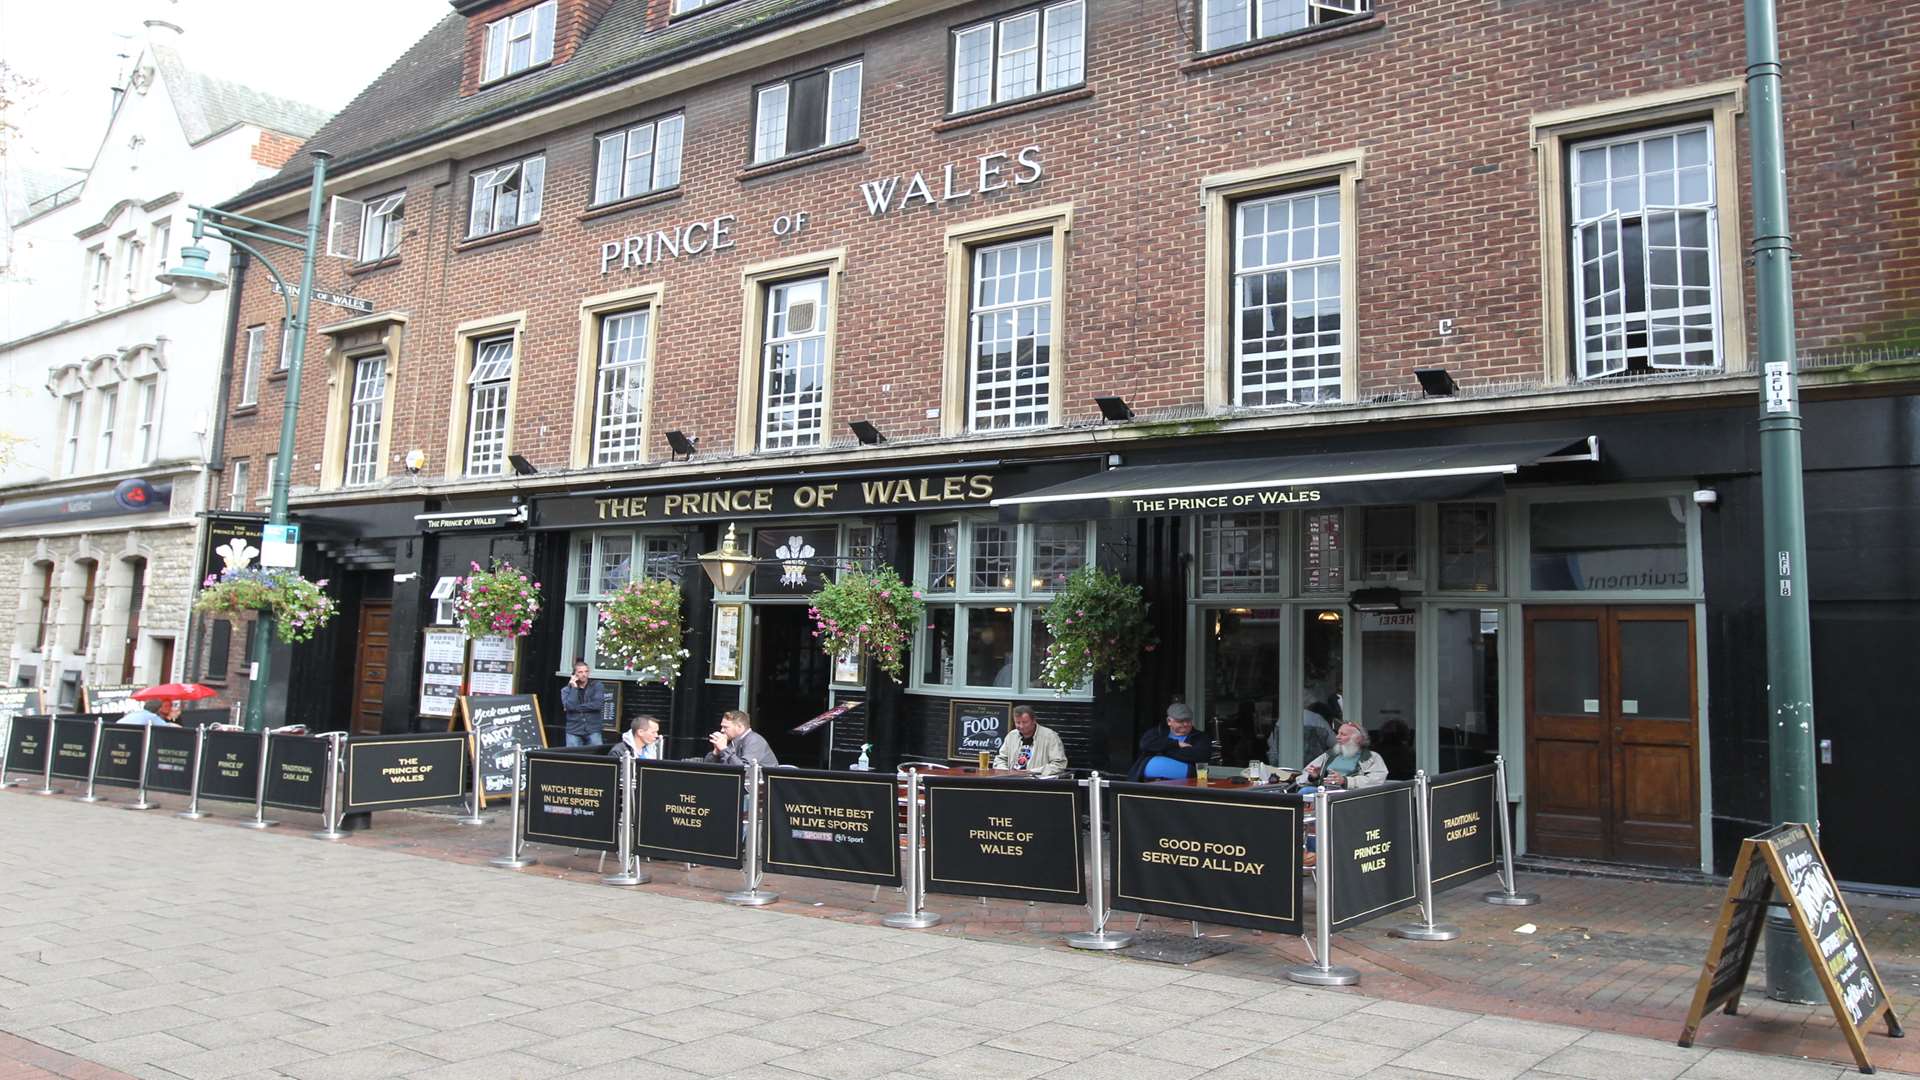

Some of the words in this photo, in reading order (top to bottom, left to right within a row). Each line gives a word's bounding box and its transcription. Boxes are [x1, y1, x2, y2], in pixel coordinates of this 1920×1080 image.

[601, 214, 736, 274] PRINCE
[773, 211, 808, 235] OF
[860, 144, 1042, 216] WALES
[332, 295, 365, 309] WALES
[594, 496, 648, 520] THE
[664, 488, 774, 516] PRINCE
[794, 483, 838, 508] OF
[861, 474, 994, 504] WALES
[1132, 500, 1165, 512] THE
[1168, 496, 1228, 510] PRINCE
[1232, 494, 1254, 506] OF
[1258, 490, 1321, 504] WALES
[440, 519, 462, 528] PRINCE
[963, 717, 999, 736] FOOD
[481, 726, 513, 747] PARTY
[382, 766, 418, 775] PRINCE
[390, 774, 424, 784] WALES
[541, 784, 566, 794] WATCH
[568, 786, 582, 795] THE
[584, 788, 604, 797] BEST
[544, 795, 551, 803] IN
[552, 796, 569, 805] LIVE
[570, 798, 600, 808] SPORTS
[680, 794, 697, 804] THE
[665, 804, 696, 815] PRINCE
[698, 808, 710, 816] OF
[784, 803, 821, 815] WATCH
[822, 806, 844, 817] THE
[846, 809, 874, 820] BEST
[672, 816, 702, 828] WALES
[790, 816, 800, 826] IN
[802, 818, 826, 828] LIVE
[827, 820, 869, 832] SPORTS
[988, 817, 1013, 827] THE
[1444, 811, 1480, 829] TRADITIONAL
[970, 829, 1014, 841] PRINCE
[1017, 832, 1034, 842] OF
[1366, 829, 1380, 841] THE
[1446, 830, 1462, 842] CASK
[1462, 825, 1478, 838] ALES
[980, 844, 1023, 856] WALES
[1159, 838, 1201, 852] GOOD
[1204, 842, 1246, 857] FOOD
[1354, 844, 1381, 860] PRINCE
[1381, 841, 1392, 853] OF
[1142, 851, 1199, 867] SERVED
[1202, 858, 1232, 872] ALL
[1234, 861, 1264, 875] DAY
[1361, 858, 1386, 873] WALES
